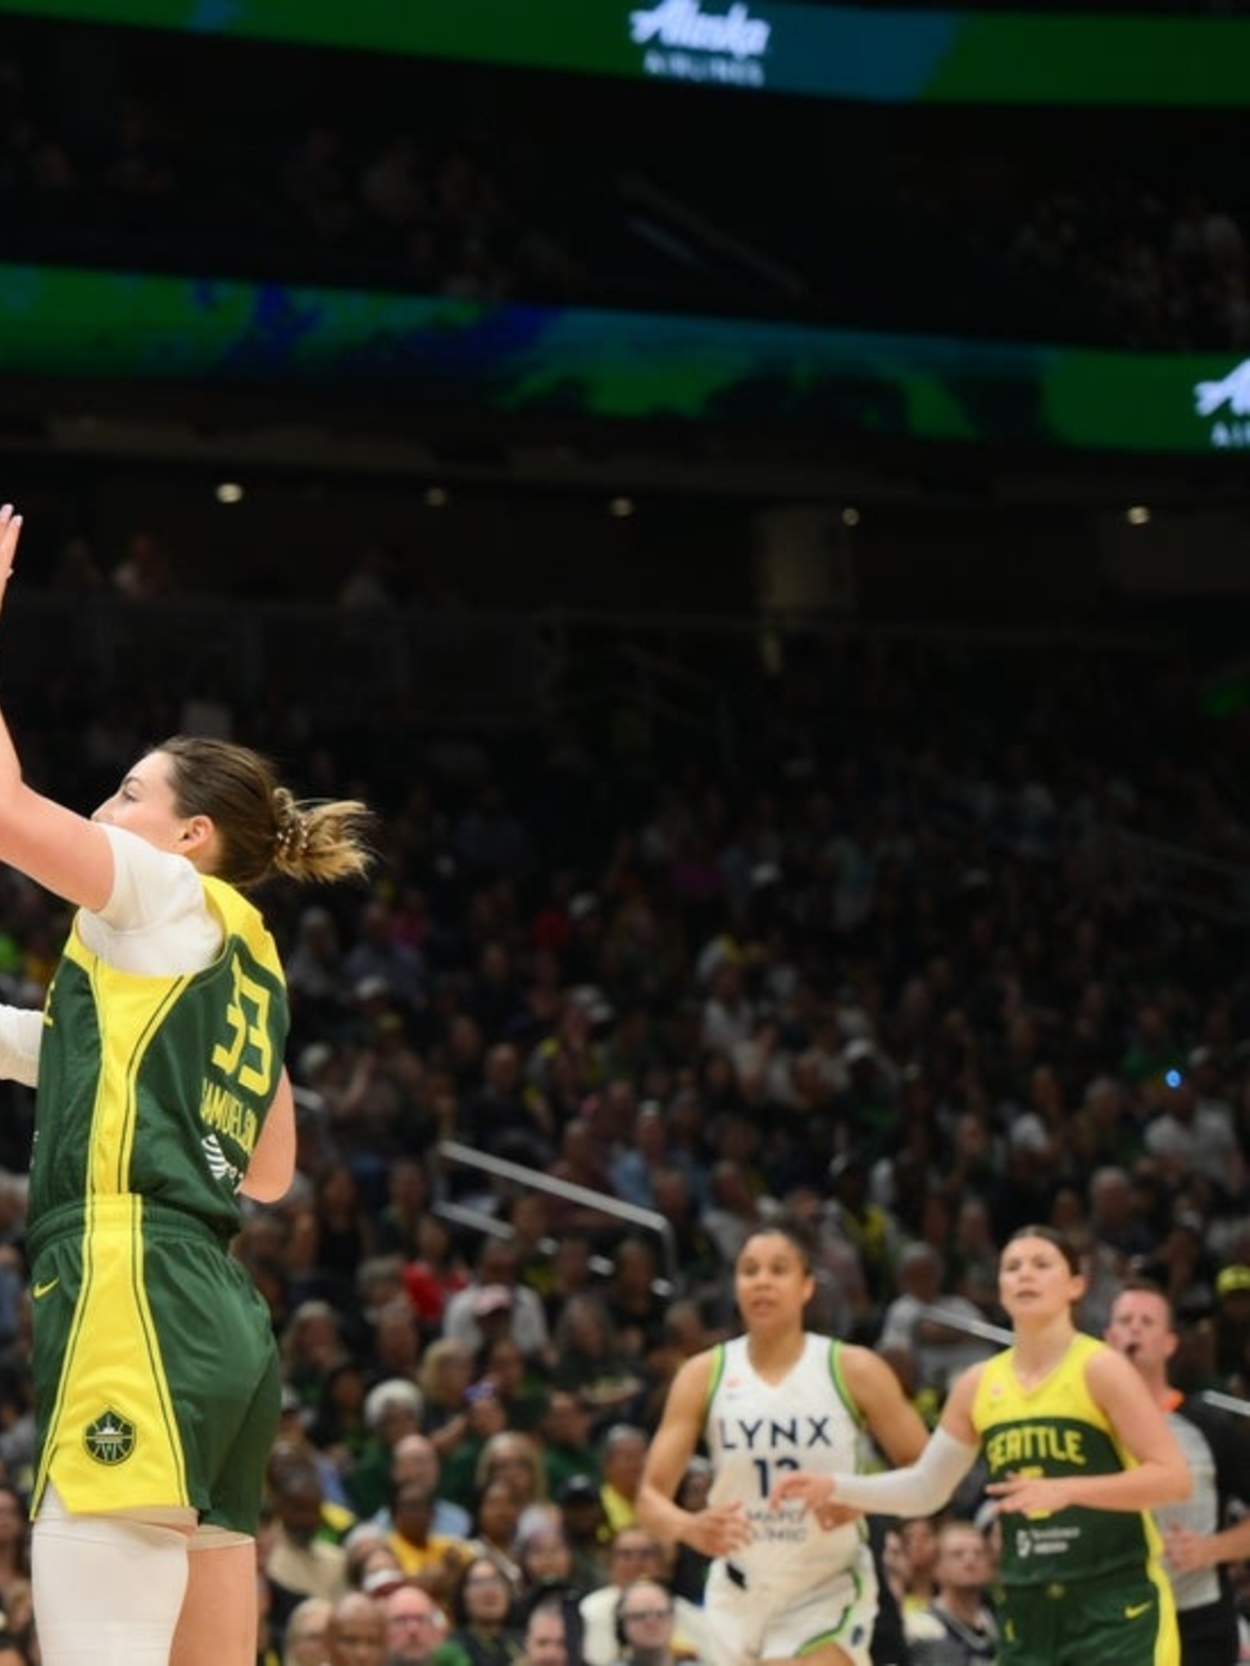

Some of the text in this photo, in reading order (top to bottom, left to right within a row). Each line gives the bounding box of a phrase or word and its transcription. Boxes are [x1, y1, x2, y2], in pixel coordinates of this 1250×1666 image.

[211, 952, 272, 1096] 33
[719, 1417, 831, 1449] LYNX
[986, 1426, 1087, 1474] SEATTLE
